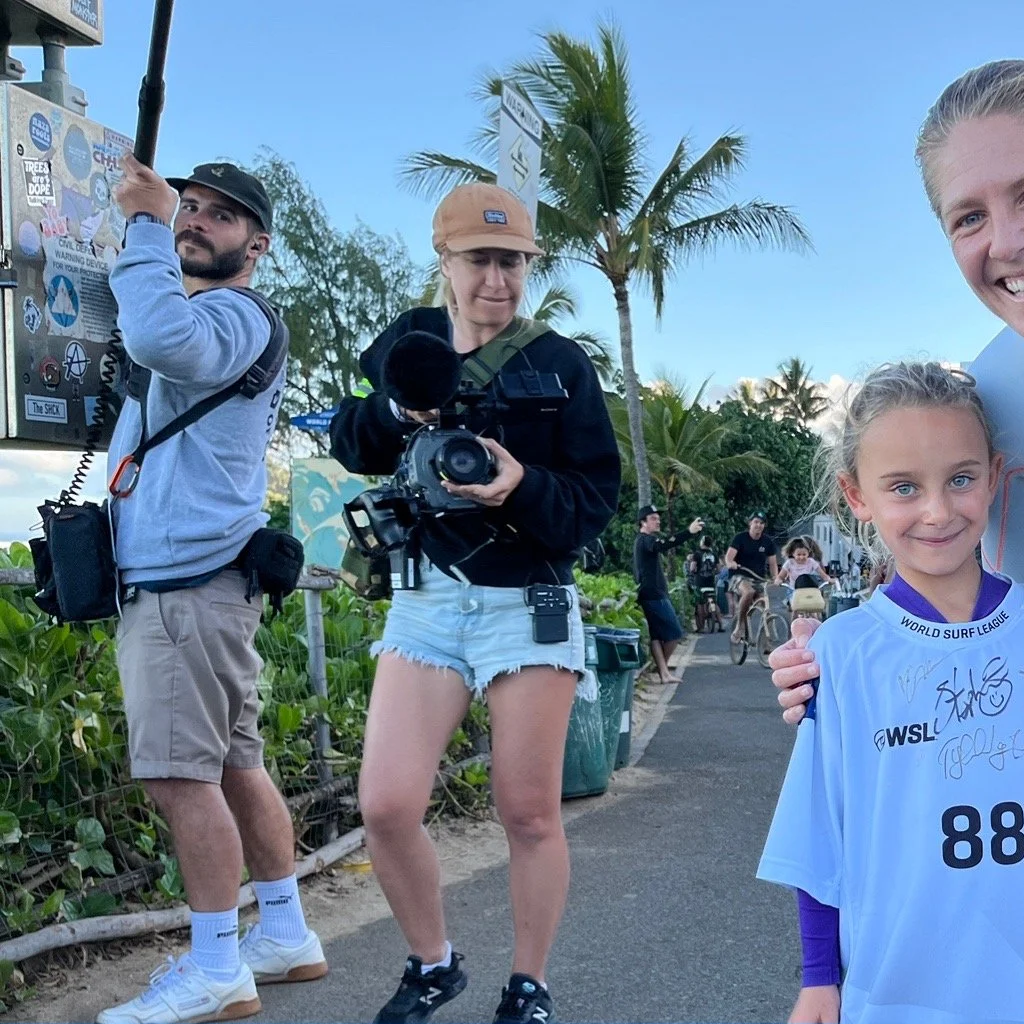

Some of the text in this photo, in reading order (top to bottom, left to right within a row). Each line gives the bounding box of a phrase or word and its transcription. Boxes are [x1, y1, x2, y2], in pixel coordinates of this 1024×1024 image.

[24, 160, 49, 175] TREES
[28, 182, 51, 195] DOPE
[58, 238, 74, 251] CIVIL
[52, 261, 64, 270] FOR
[65, 263, 79, 273] YOUR
[54, 249, 109, 272] WARNING DEVICE
[900, 610, 1010, 640] WORLD SURF LEAGUE
[886, 722, 936, 748] WSL
